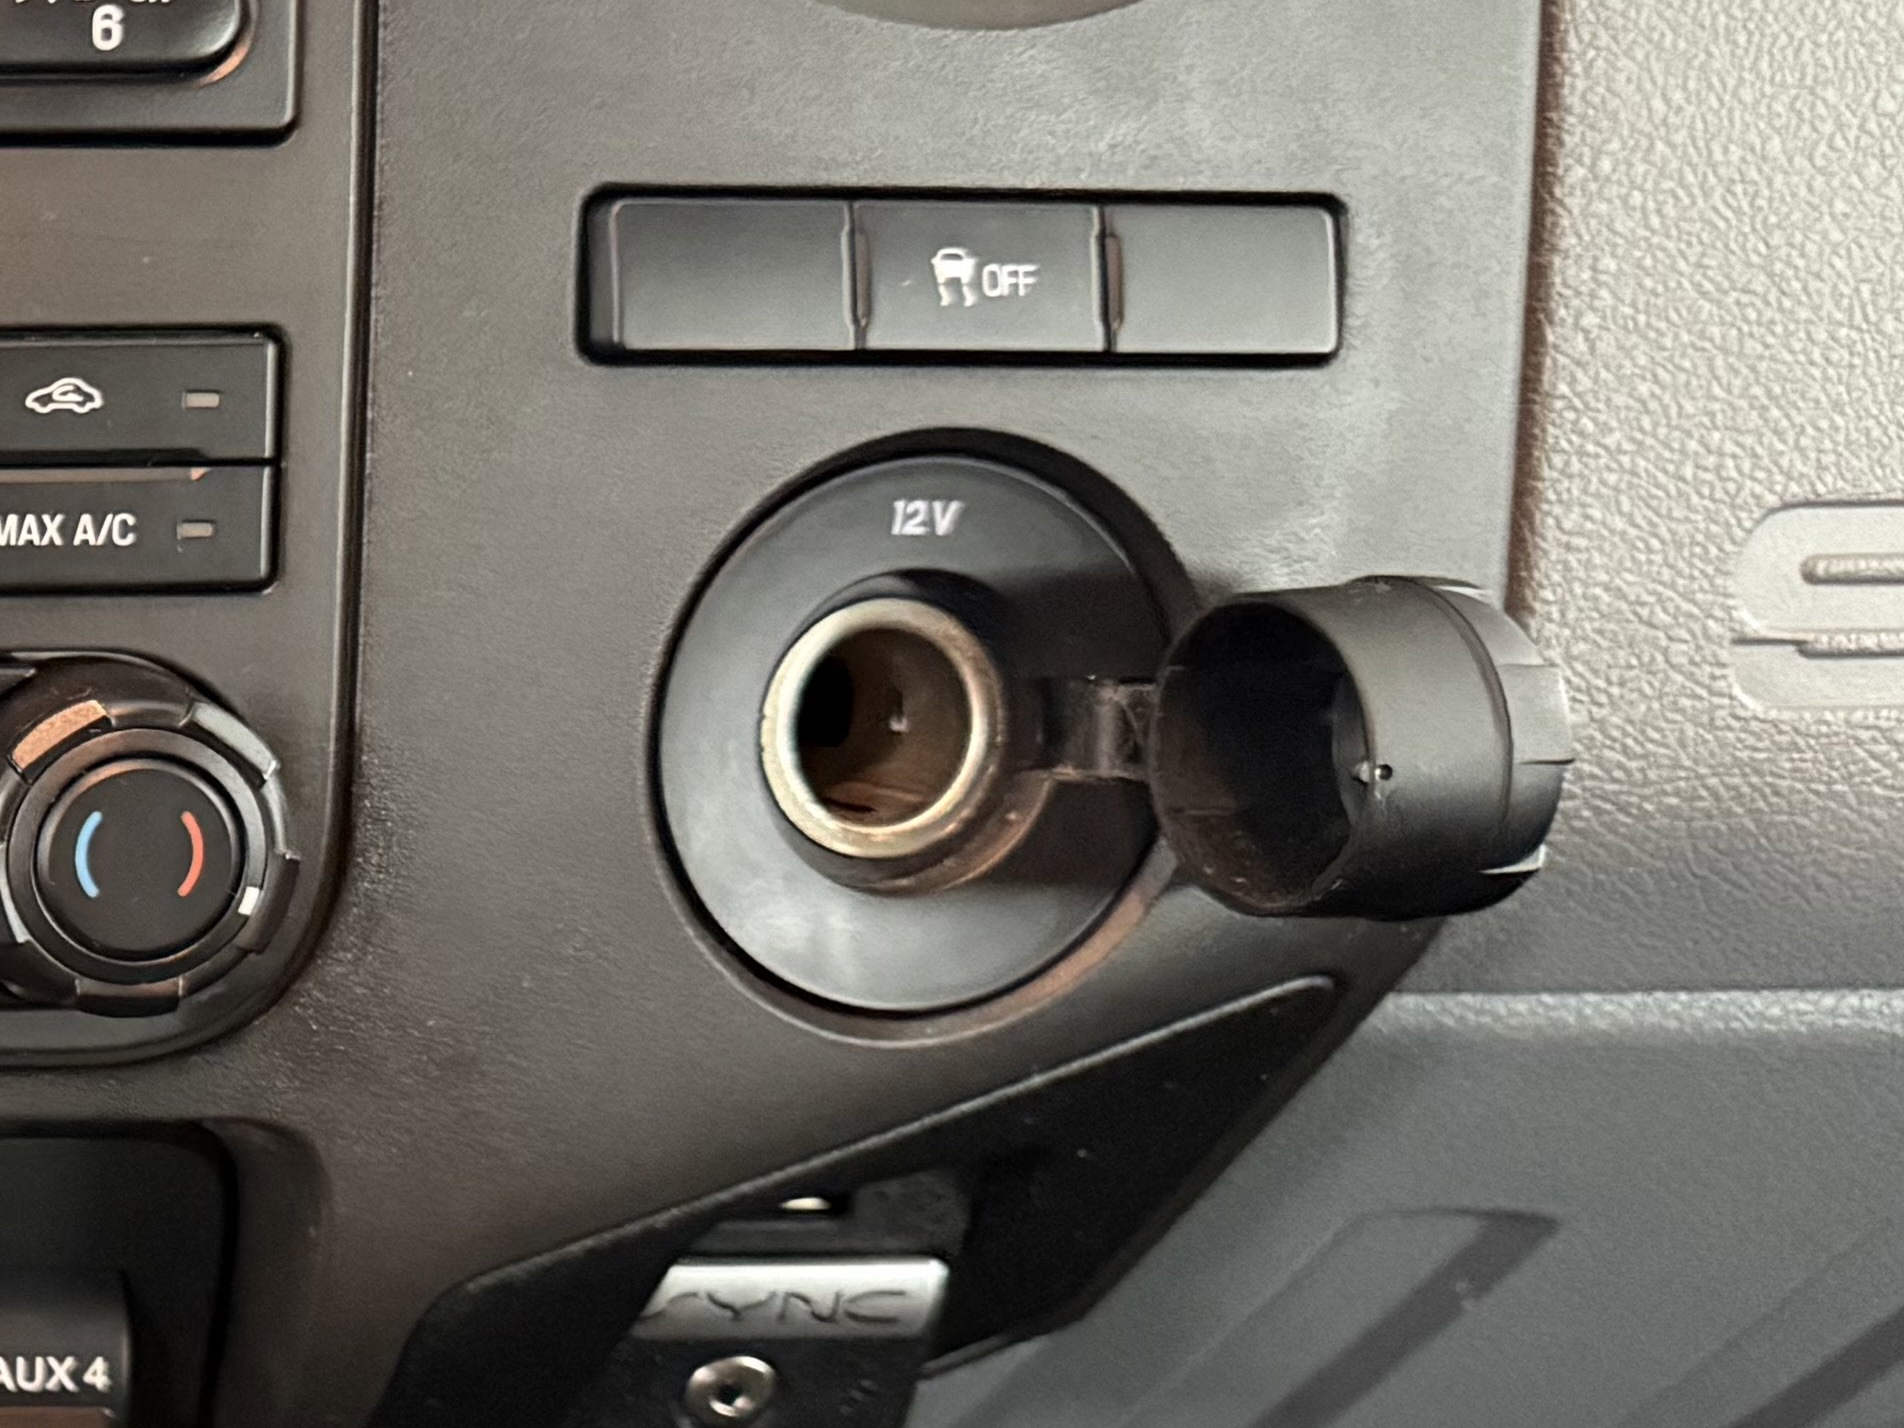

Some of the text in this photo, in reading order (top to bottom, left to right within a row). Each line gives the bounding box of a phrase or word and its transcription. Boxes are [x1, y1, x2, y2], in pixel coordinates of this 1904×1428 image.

[89, 5, 126, 52] 6
[979, 262, 1040, 300] OFF
[72, 511, 137, 549] A/C
[889, 498, 963, 538] 12V
[81, 1355, 111, 1393] 4
